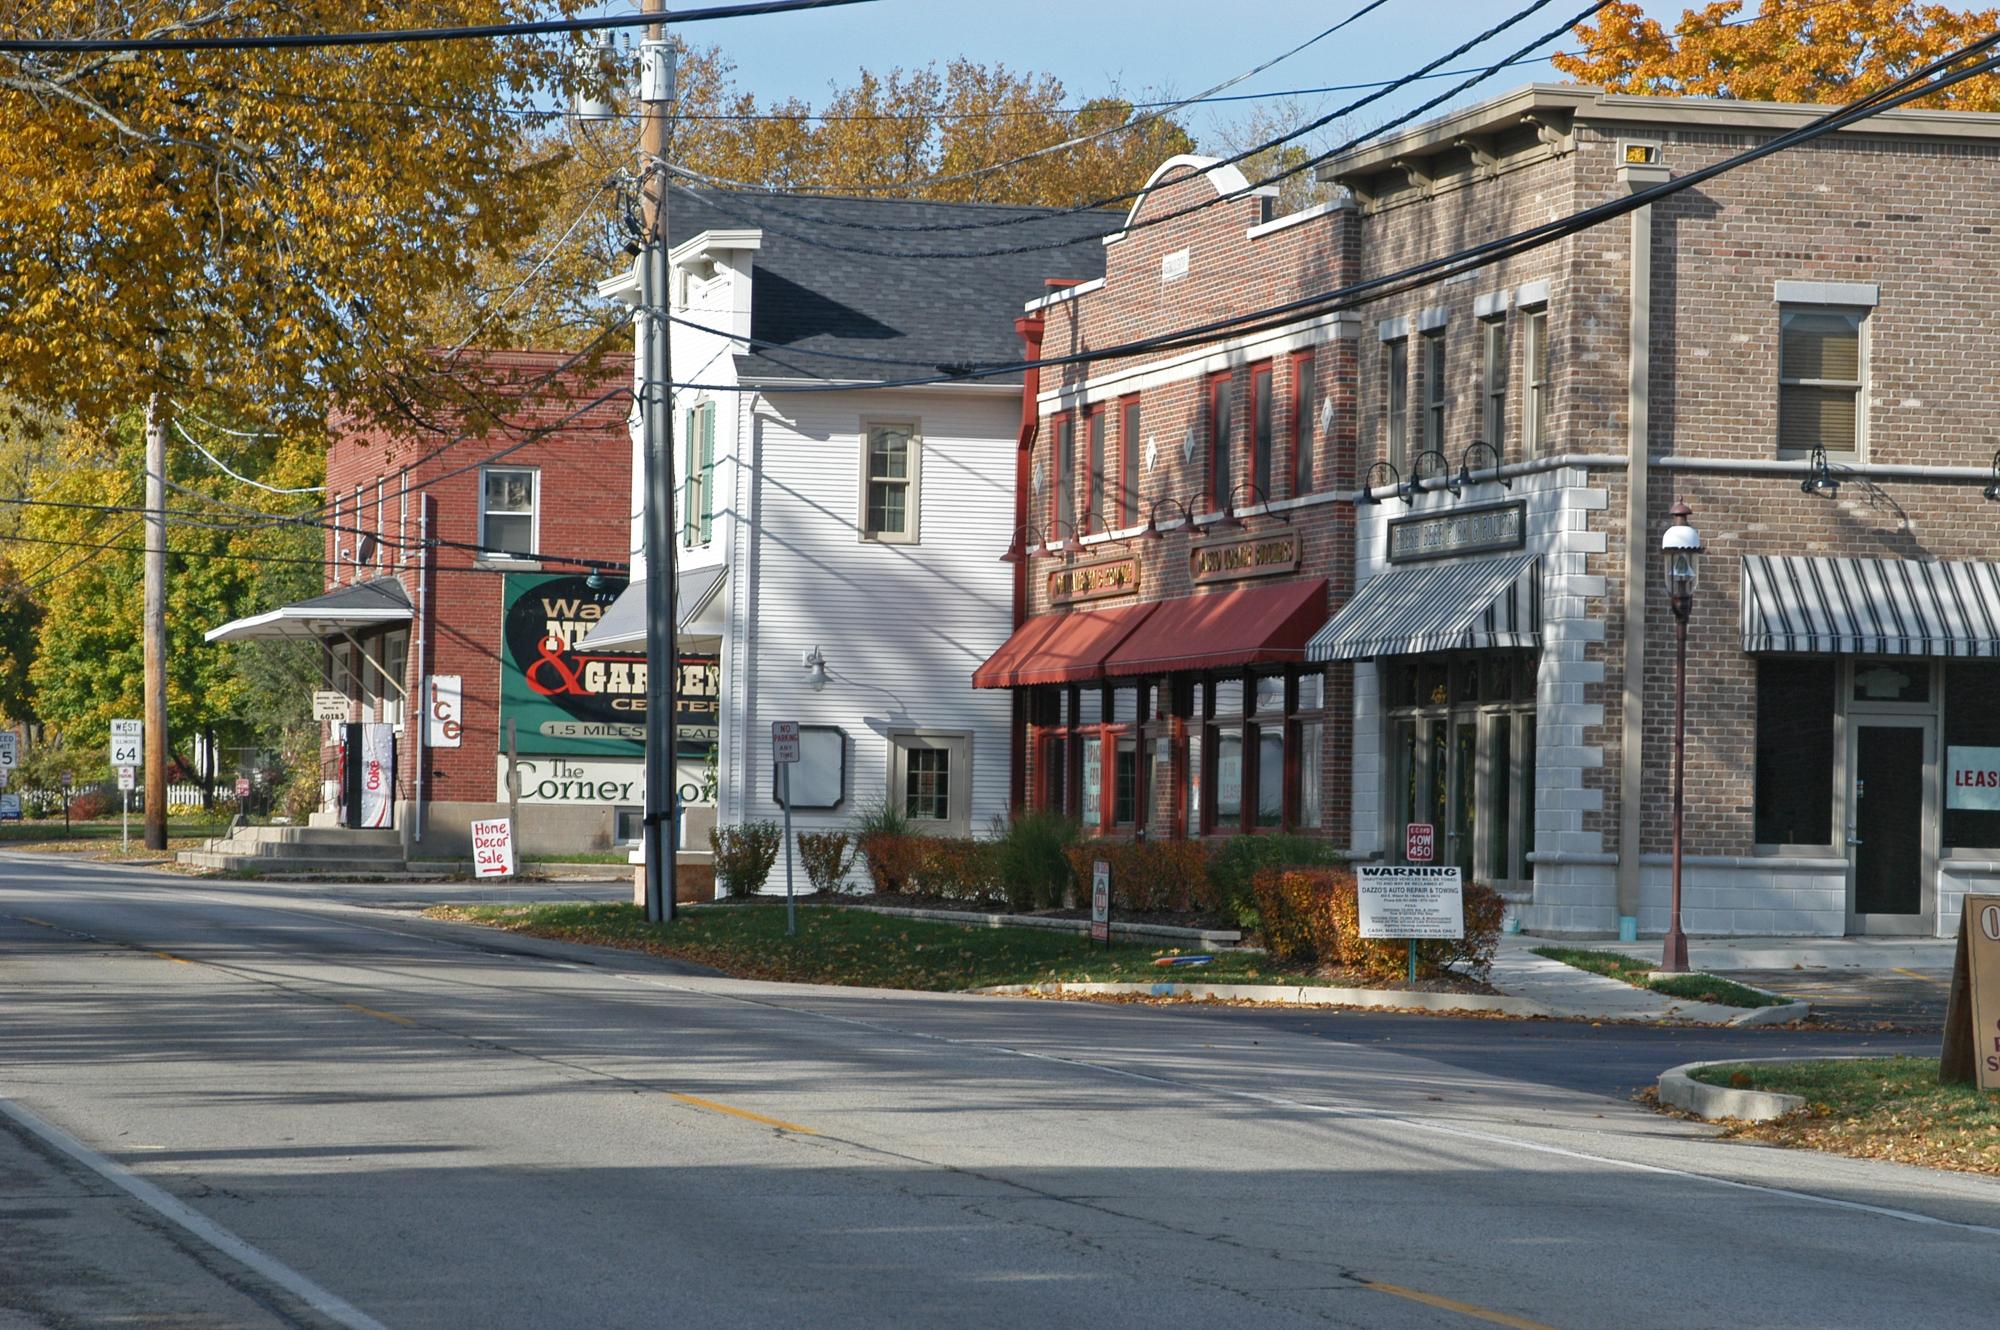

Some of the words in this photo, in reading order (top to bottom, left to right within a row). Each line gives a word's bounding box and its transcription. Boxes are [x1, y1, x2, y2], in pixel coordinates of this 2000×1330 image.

[1446, 518, 1468, 545] PORK
[585, 661, 720, 696] GAREN
[611, 698, 720, 713] CETER
[115, 722, 138, 732] WEST
[549, 725, 576, 736] 1.5
[583, 726, 644, 737] MILES
[781, 724, 791, 733] NO
[774, 735, 798, 743] PARKING
[116, 747, 137, 761] 64
[780, 751, 793, 759] TIME
[366, 759, 381, 791] Coke
[549, 759, 584, 778] The
[506, 761, 634, 801] Corner
[1955, 770, 2000, 788] LEAS
[475, 836, 509, 849] Decor
[1409, 835, 1431, 845] 40W
[477, 850, 504, 864] Sale
[1409, 846, 1431, 857] 450
[1361, 868, 1457, 877] WARNING
[1435, 887, 1459, 895] TOWING
